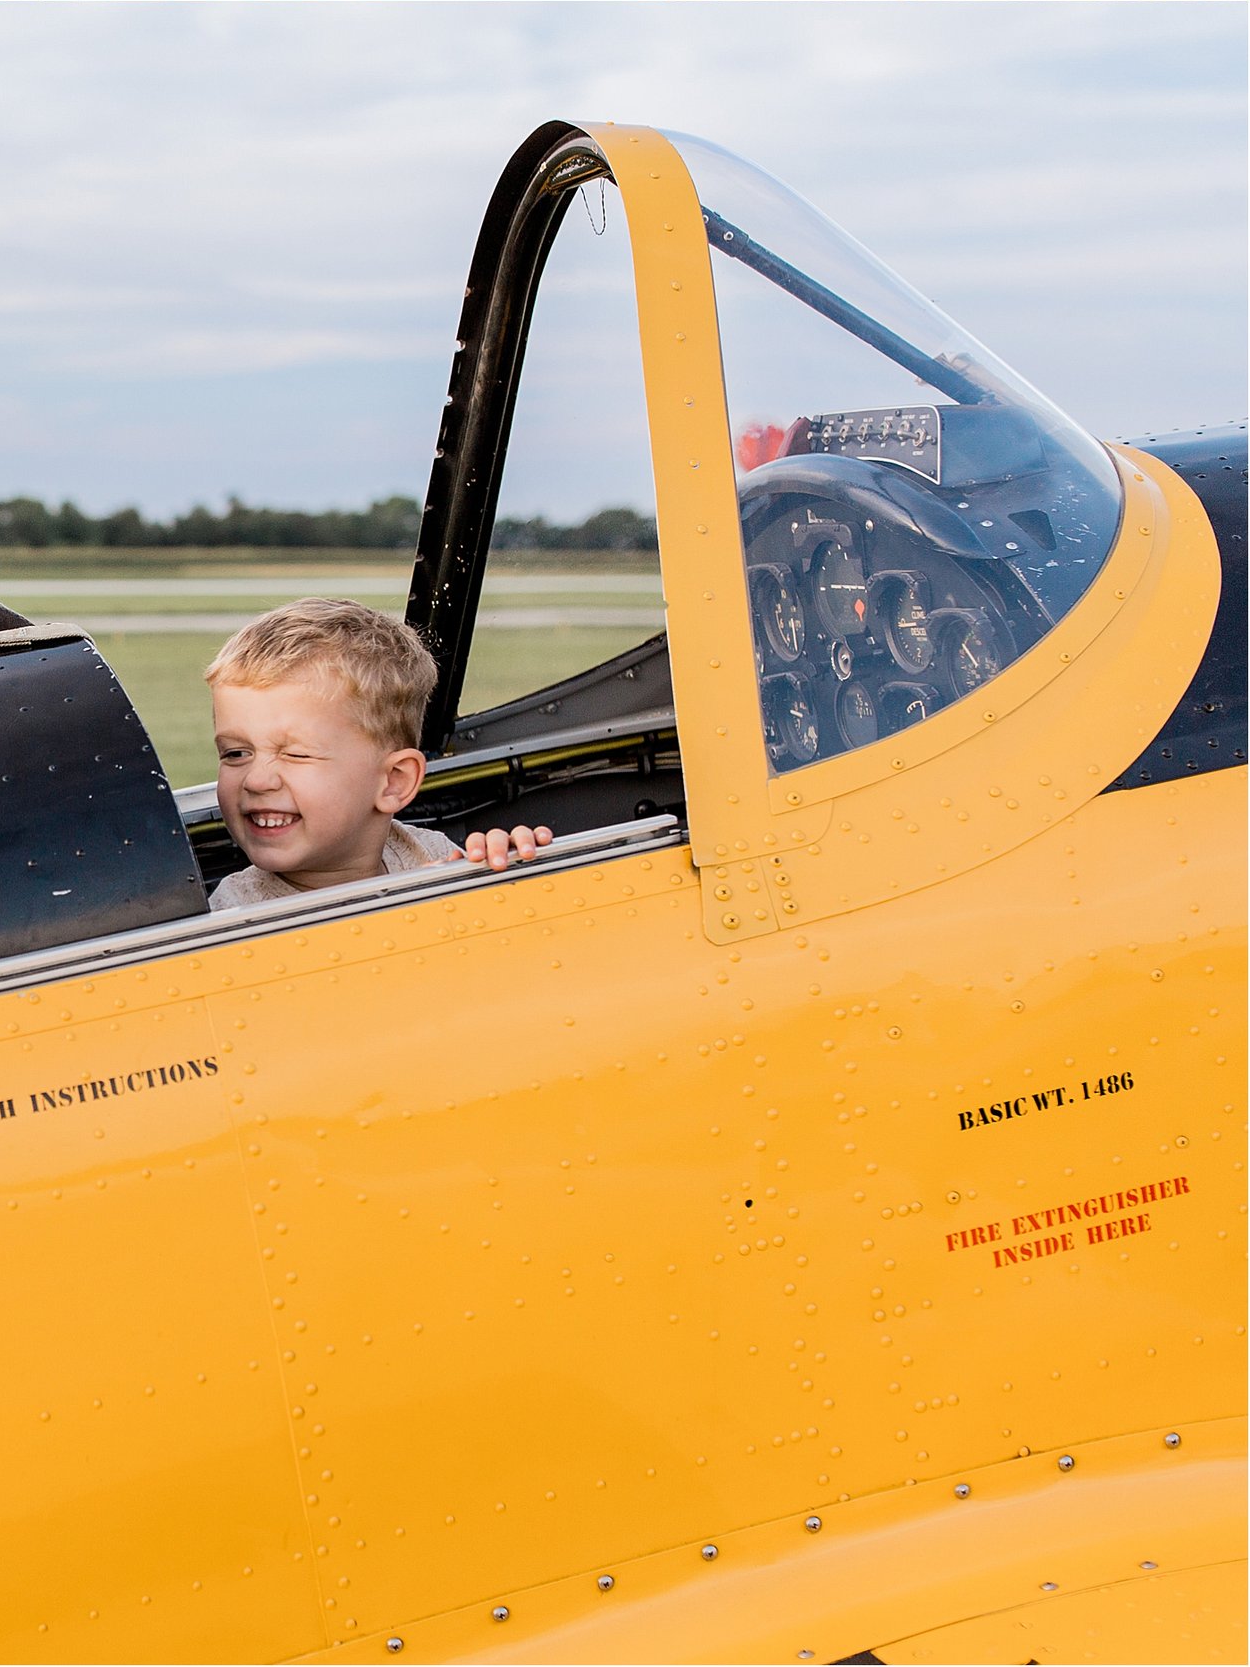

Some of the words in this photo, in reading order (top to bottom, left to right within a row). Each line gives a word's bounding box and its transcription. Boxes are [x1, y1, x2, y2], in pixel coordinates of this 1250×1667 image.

[30, 1056, 218, 1112] INSTRUCTIONS
[958, 1097, 1028, 1131] BASIC
[1032, 1087, 1074, 1111] WT.
[1082, 1071, 1135, 1100] 1486
[945, 1222, 1002, 1252] FIRE
[1012, 1176, 1191, 1236] EXTINGUISHER
[993, 1232, 1075, 1269] INSIDE
[1086, 1213, 1152, 1245] HERE
